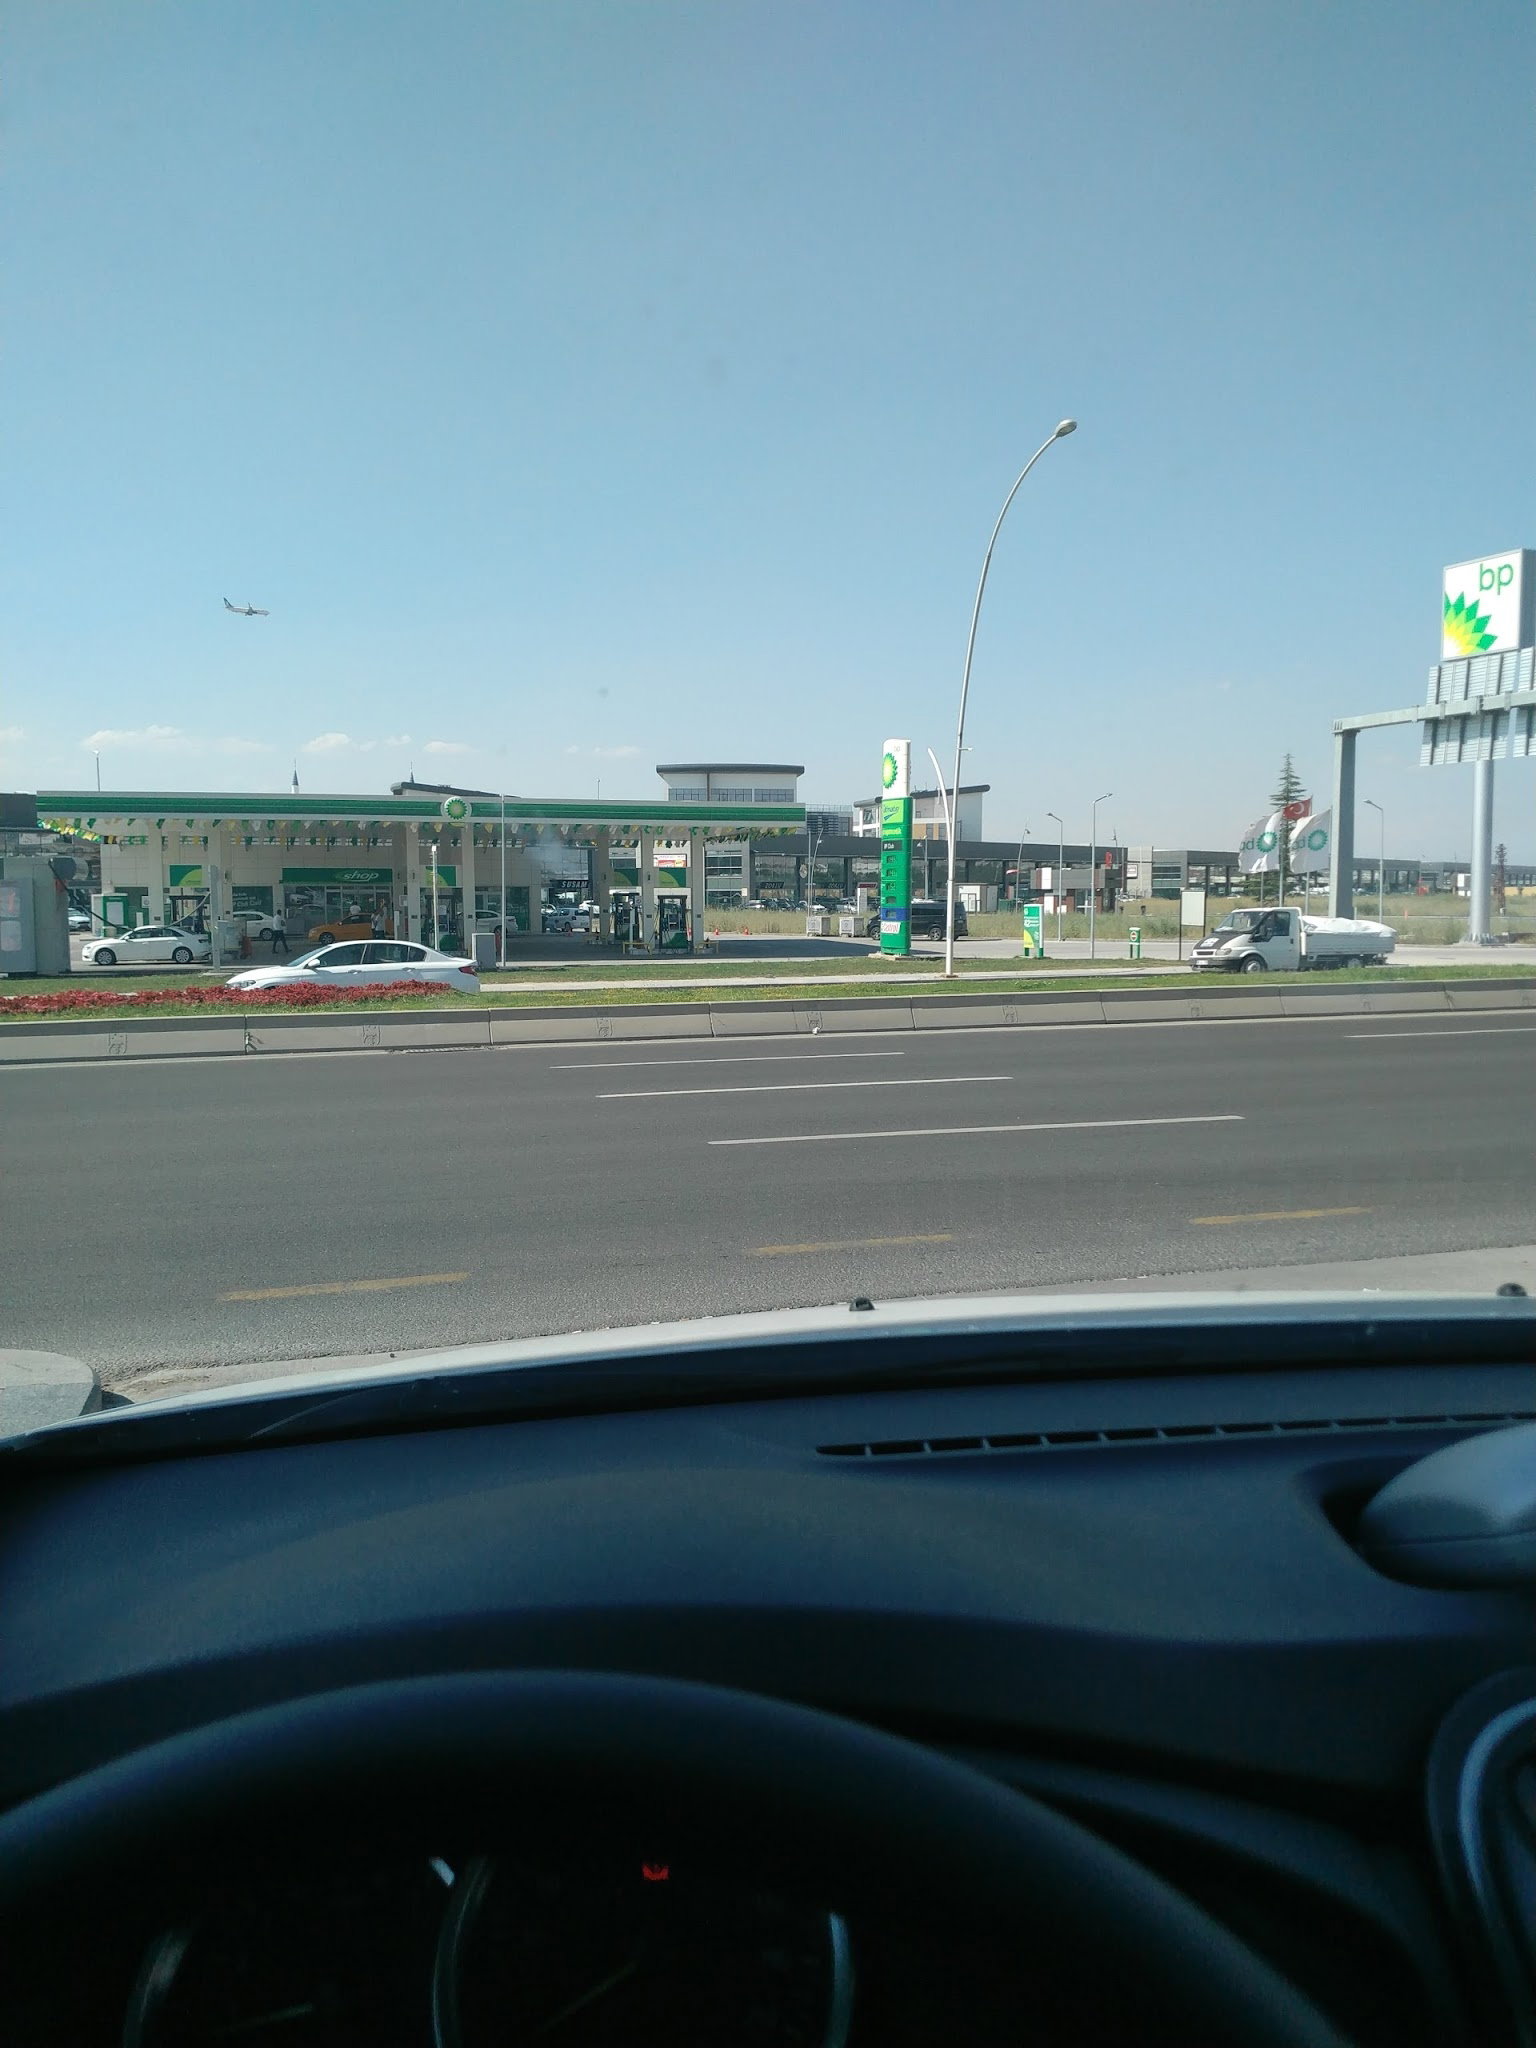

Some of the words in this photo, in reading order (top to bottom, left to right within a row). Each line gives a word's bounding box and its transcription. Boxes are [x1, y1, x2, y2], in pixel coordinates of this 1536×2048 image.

[1479, 563, 1514, 596] bp
[344, 870, 380, 882] shop
[561, 880, 588, 888] SUSAM
